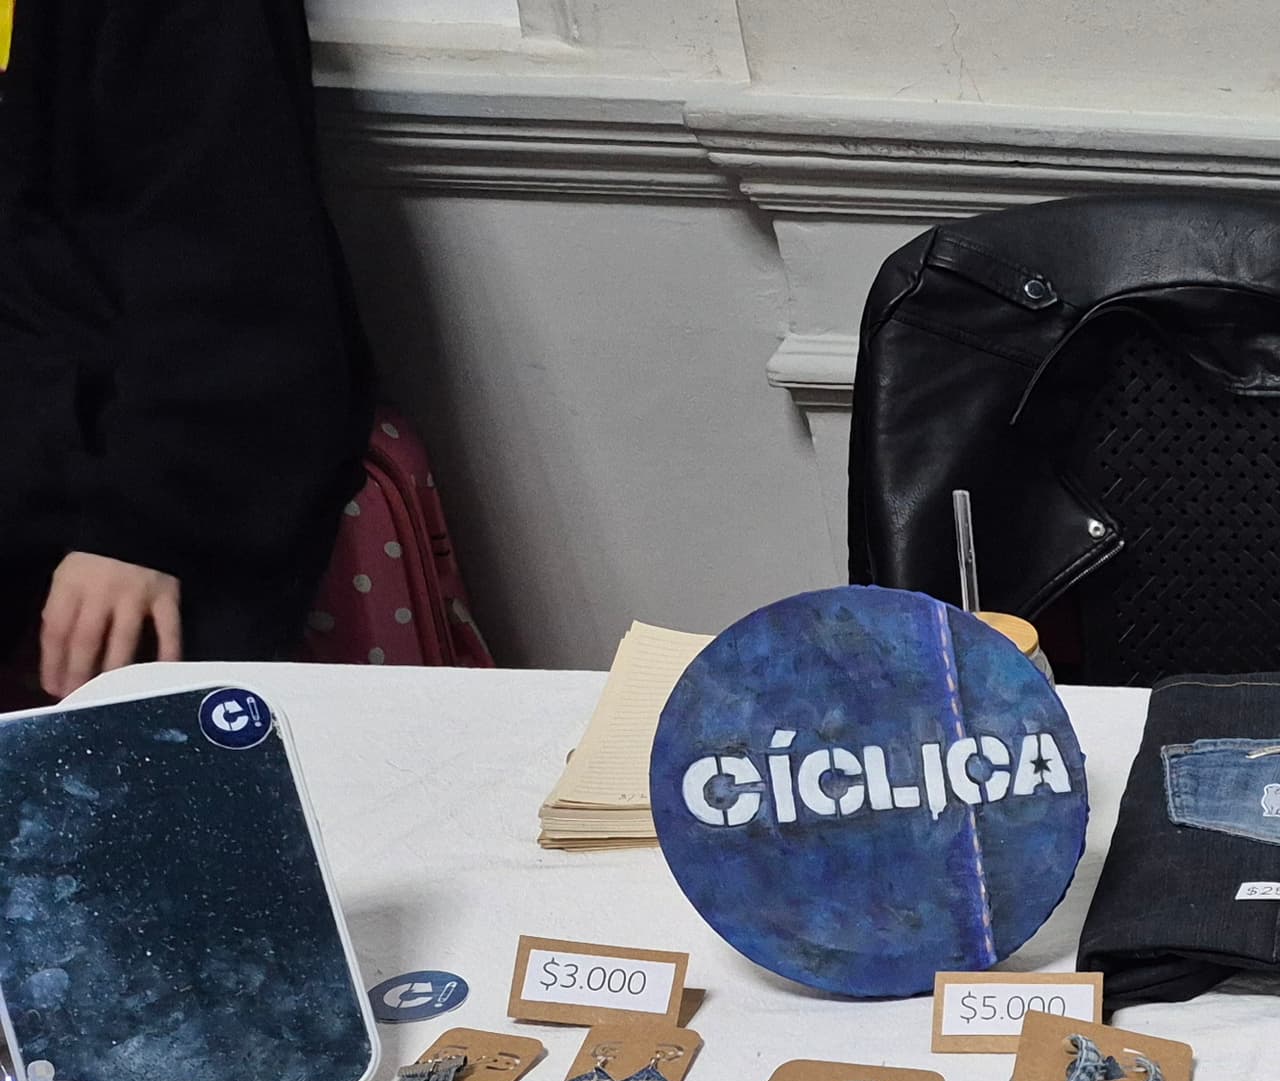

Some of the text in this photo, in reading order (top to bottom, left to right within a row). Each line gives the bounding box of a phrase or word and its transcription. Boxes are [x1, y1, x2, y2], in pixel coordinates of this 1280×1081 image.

[681, 729, 1073, 828] CÍCLICA
[539, 956, 647, 996] $3.000
[959, 989, 1067, 1025] $5.000
